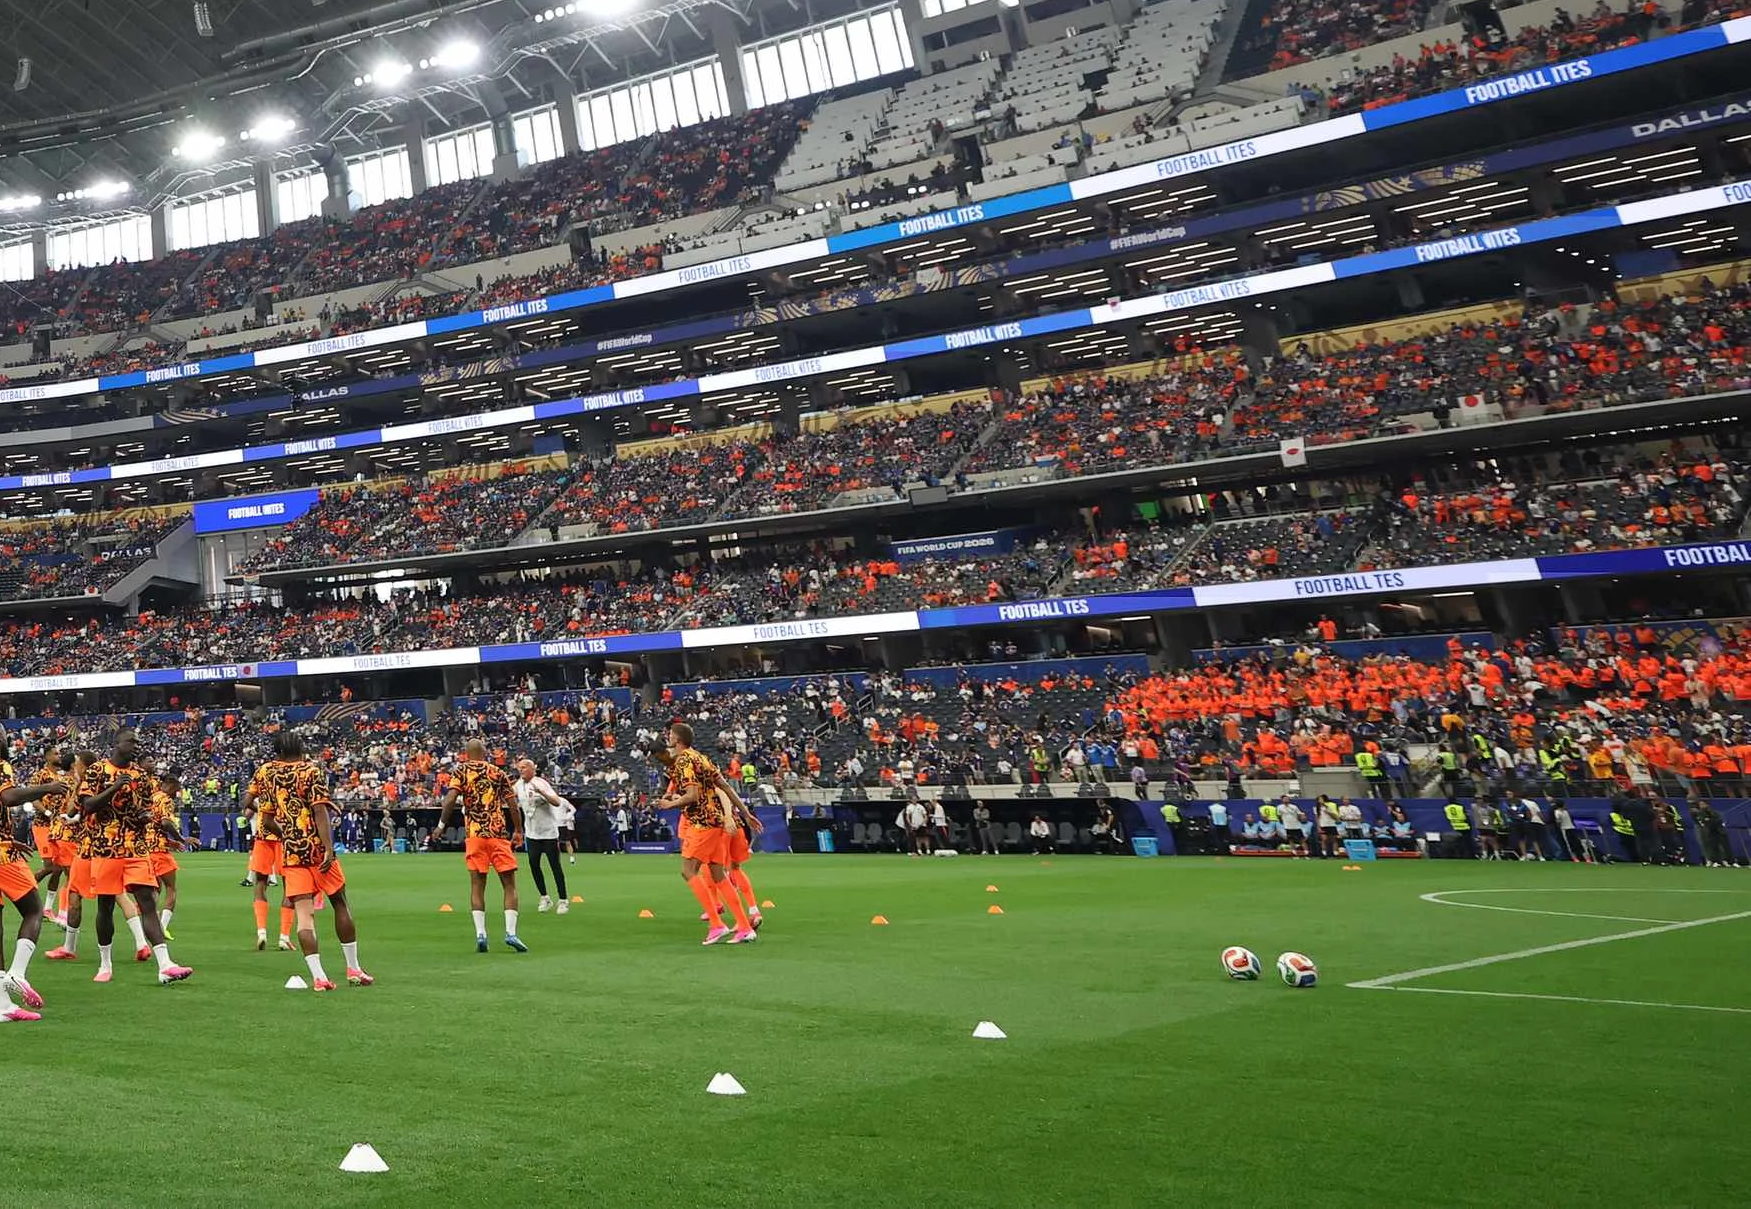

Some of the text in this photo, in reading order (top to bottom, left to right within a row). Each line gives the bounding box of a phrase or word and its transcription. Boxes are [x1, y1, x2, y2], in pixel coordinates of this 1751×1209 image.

[1466, 60, 1592, 103] FOOTBALL ITES
[1157, 142, 1256, 176] FOOTBALL ITES
[900, 205, 984, 237] FOOTBALL ITES
[1110, 226, 1186, 250] #FIFAWorldCup
[1415, 235, 1483, 262] FOOTBALL
[679, 257, 750, 283] FOOTBALL ITES
[1164, 288, 1217, 309] FOOTBALL
[483, 299, 548, 322] FOOTBALL ITES
[308, 335, 365, 354] FOOTBALL ITES
[946, 328, 994, 349] FOOTBALL
[146, 366, 182, 382] FOOTBALL
[756, 362, 798, 381] FOOTBALL
[584, 394, 622, 410] FOOTBALL
[428, 420, 463, 432] FOOTBALL
[285, 441, 316, 454] FOOTBALL
[229, 505, 262, 519] FOOTBALL
[897, 538, 994, 555] FIFA WORLD CUP 2026
[1295, 572, 1404, 595] FOOTBALL TES
[1000, 599, 1089, 620] FOOTBALL TES
[753, 622, 828, 639] FOOTBALL TES
[541, 639, 606, 656] FOOTBALL TES
[354, 654, 411, 668] FOOTBALL TES
[184, 666, 237, 680] FOOTBALL TES
[30, 677, 78, 689] FOOTBALL TES
